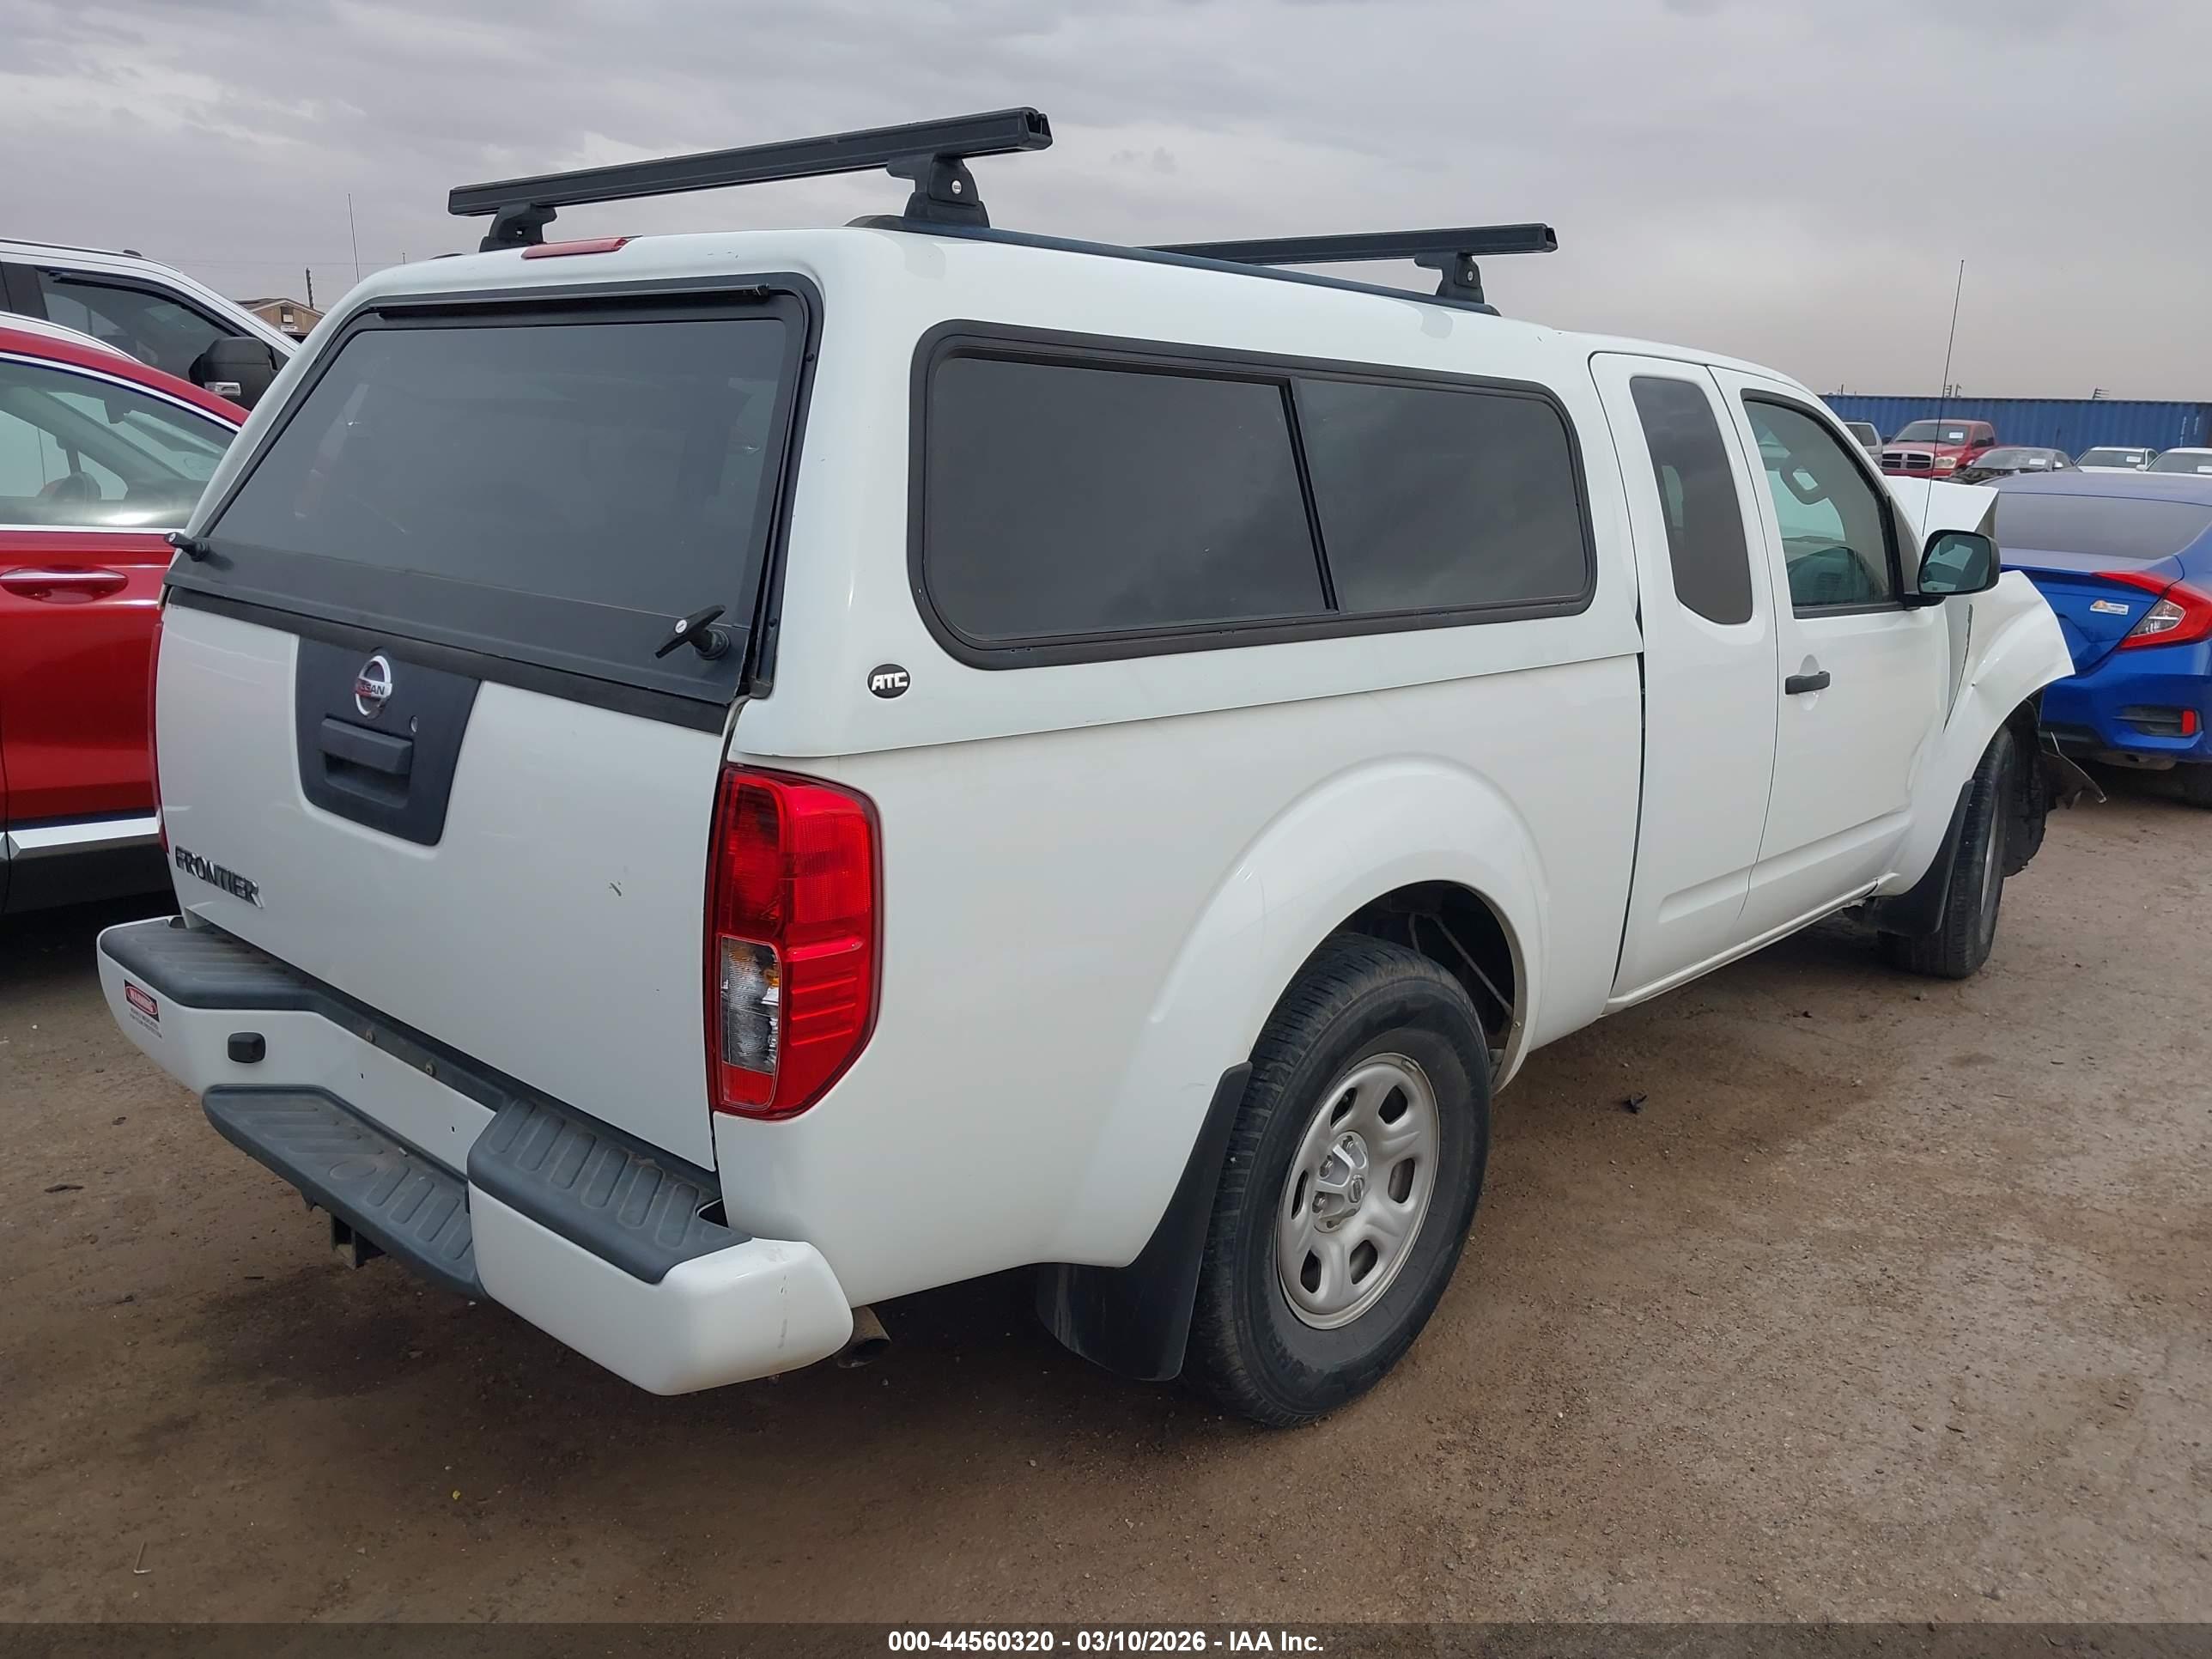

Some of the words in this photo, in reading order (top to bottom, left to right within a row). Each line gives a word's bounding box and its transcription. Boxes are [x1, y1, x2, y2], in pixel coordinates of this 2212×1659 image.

[358, 681, 386, 695] SSAN
[872, 672, 908, 690] ATC
[175, 845, 263, 908] FRONTIER
